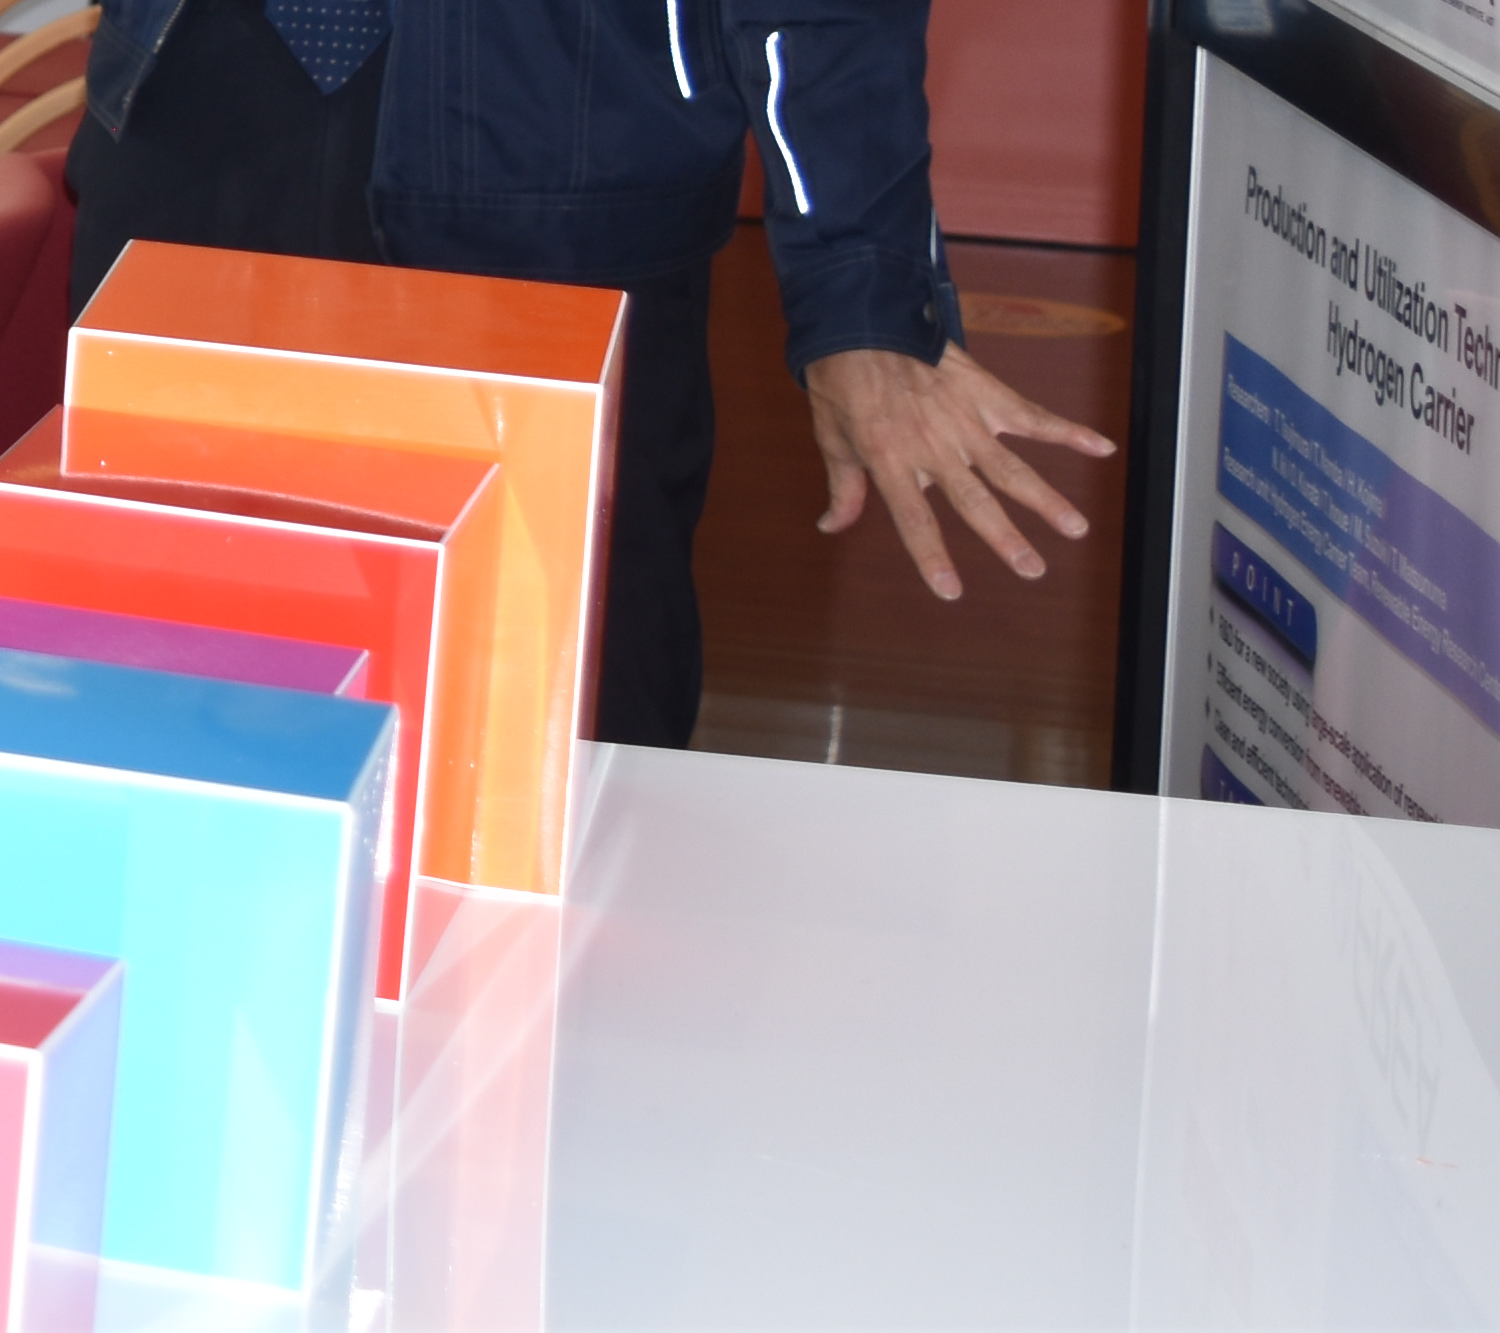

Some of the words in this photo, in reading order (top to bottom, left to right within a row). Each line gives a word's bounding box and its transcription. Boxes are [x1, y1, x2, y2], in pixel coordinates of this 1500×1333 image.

[1245, 164, 1326, 268] Production
[1330, 235, 1360, 291] and
[1364, 244, 1449, 354] Utilization
[1327, 299, 1405, 409] Hydrogen
[1410, 362, 1475, 455] Carrier
[1233, 551, 1294, 627] POINT
